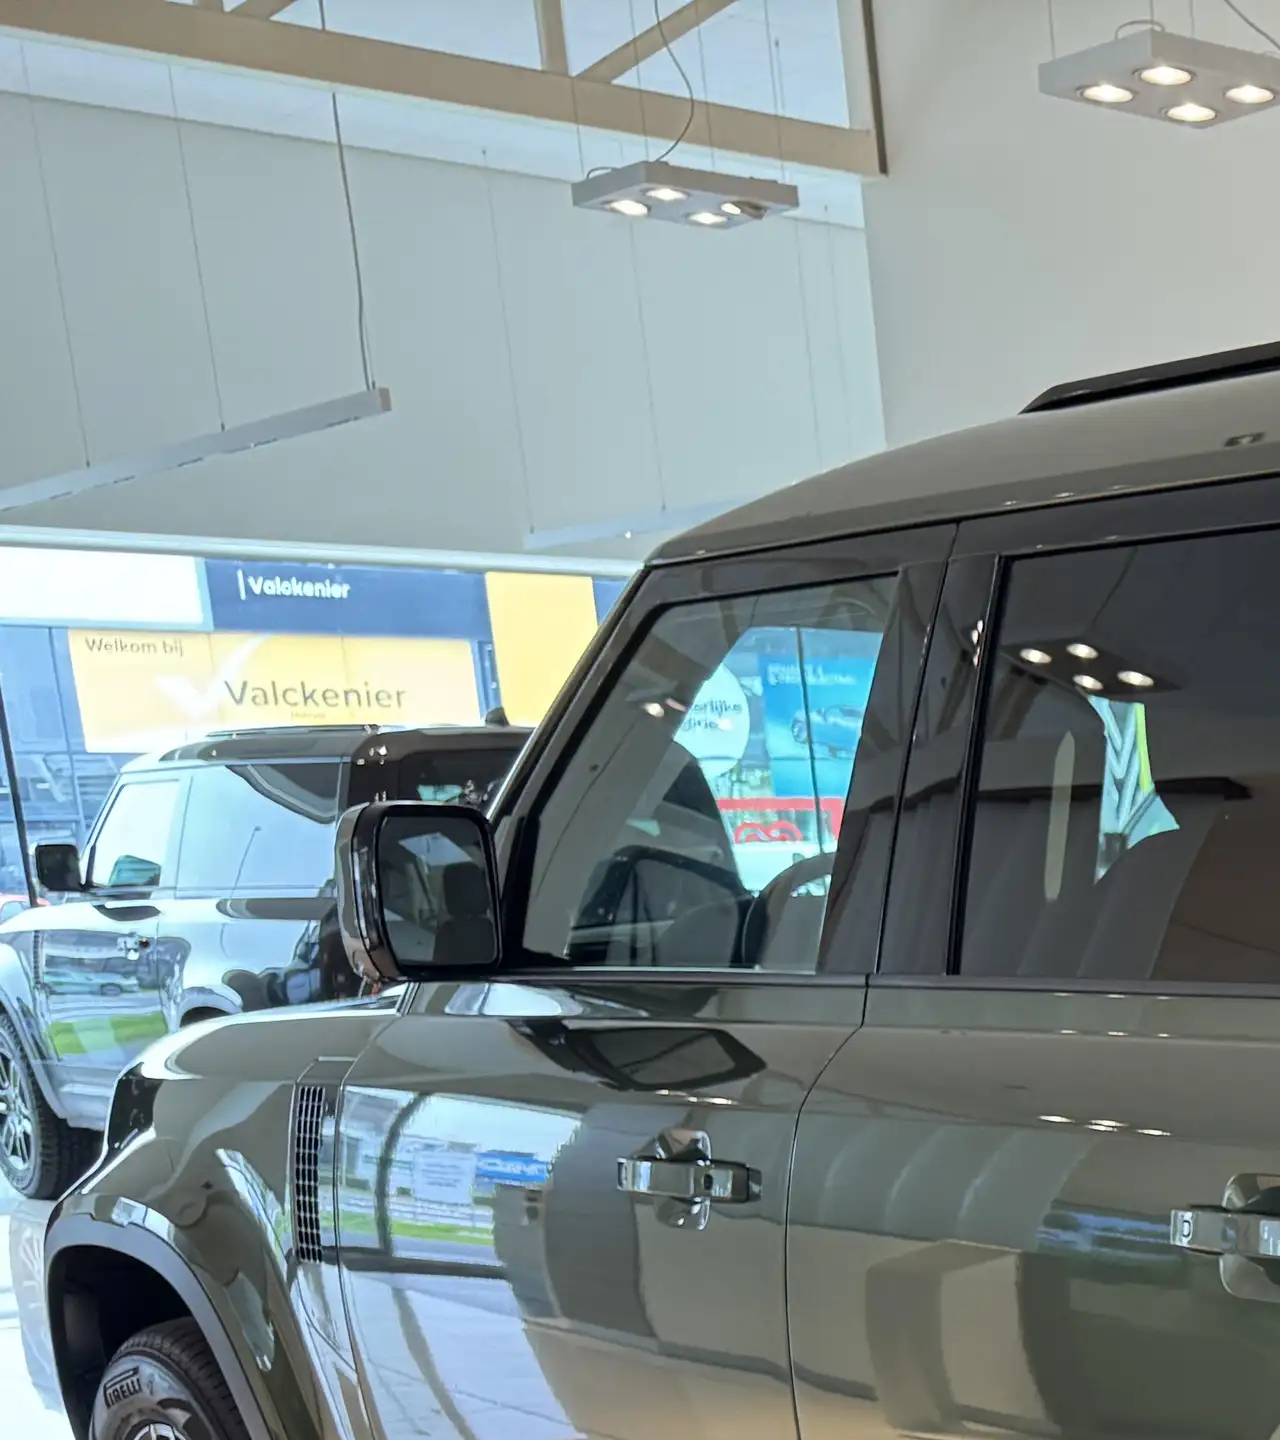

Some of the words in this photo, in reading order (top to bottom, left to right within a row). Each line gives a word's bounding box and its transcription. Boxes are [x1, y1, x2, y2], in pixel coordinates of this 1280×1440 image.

[248, 575, 351, 599] Valckenier
[85, 637, 158, 655] Welkom
[162, 639, 184, 658] bij
[223, 680, 408, 709] Valckenier
